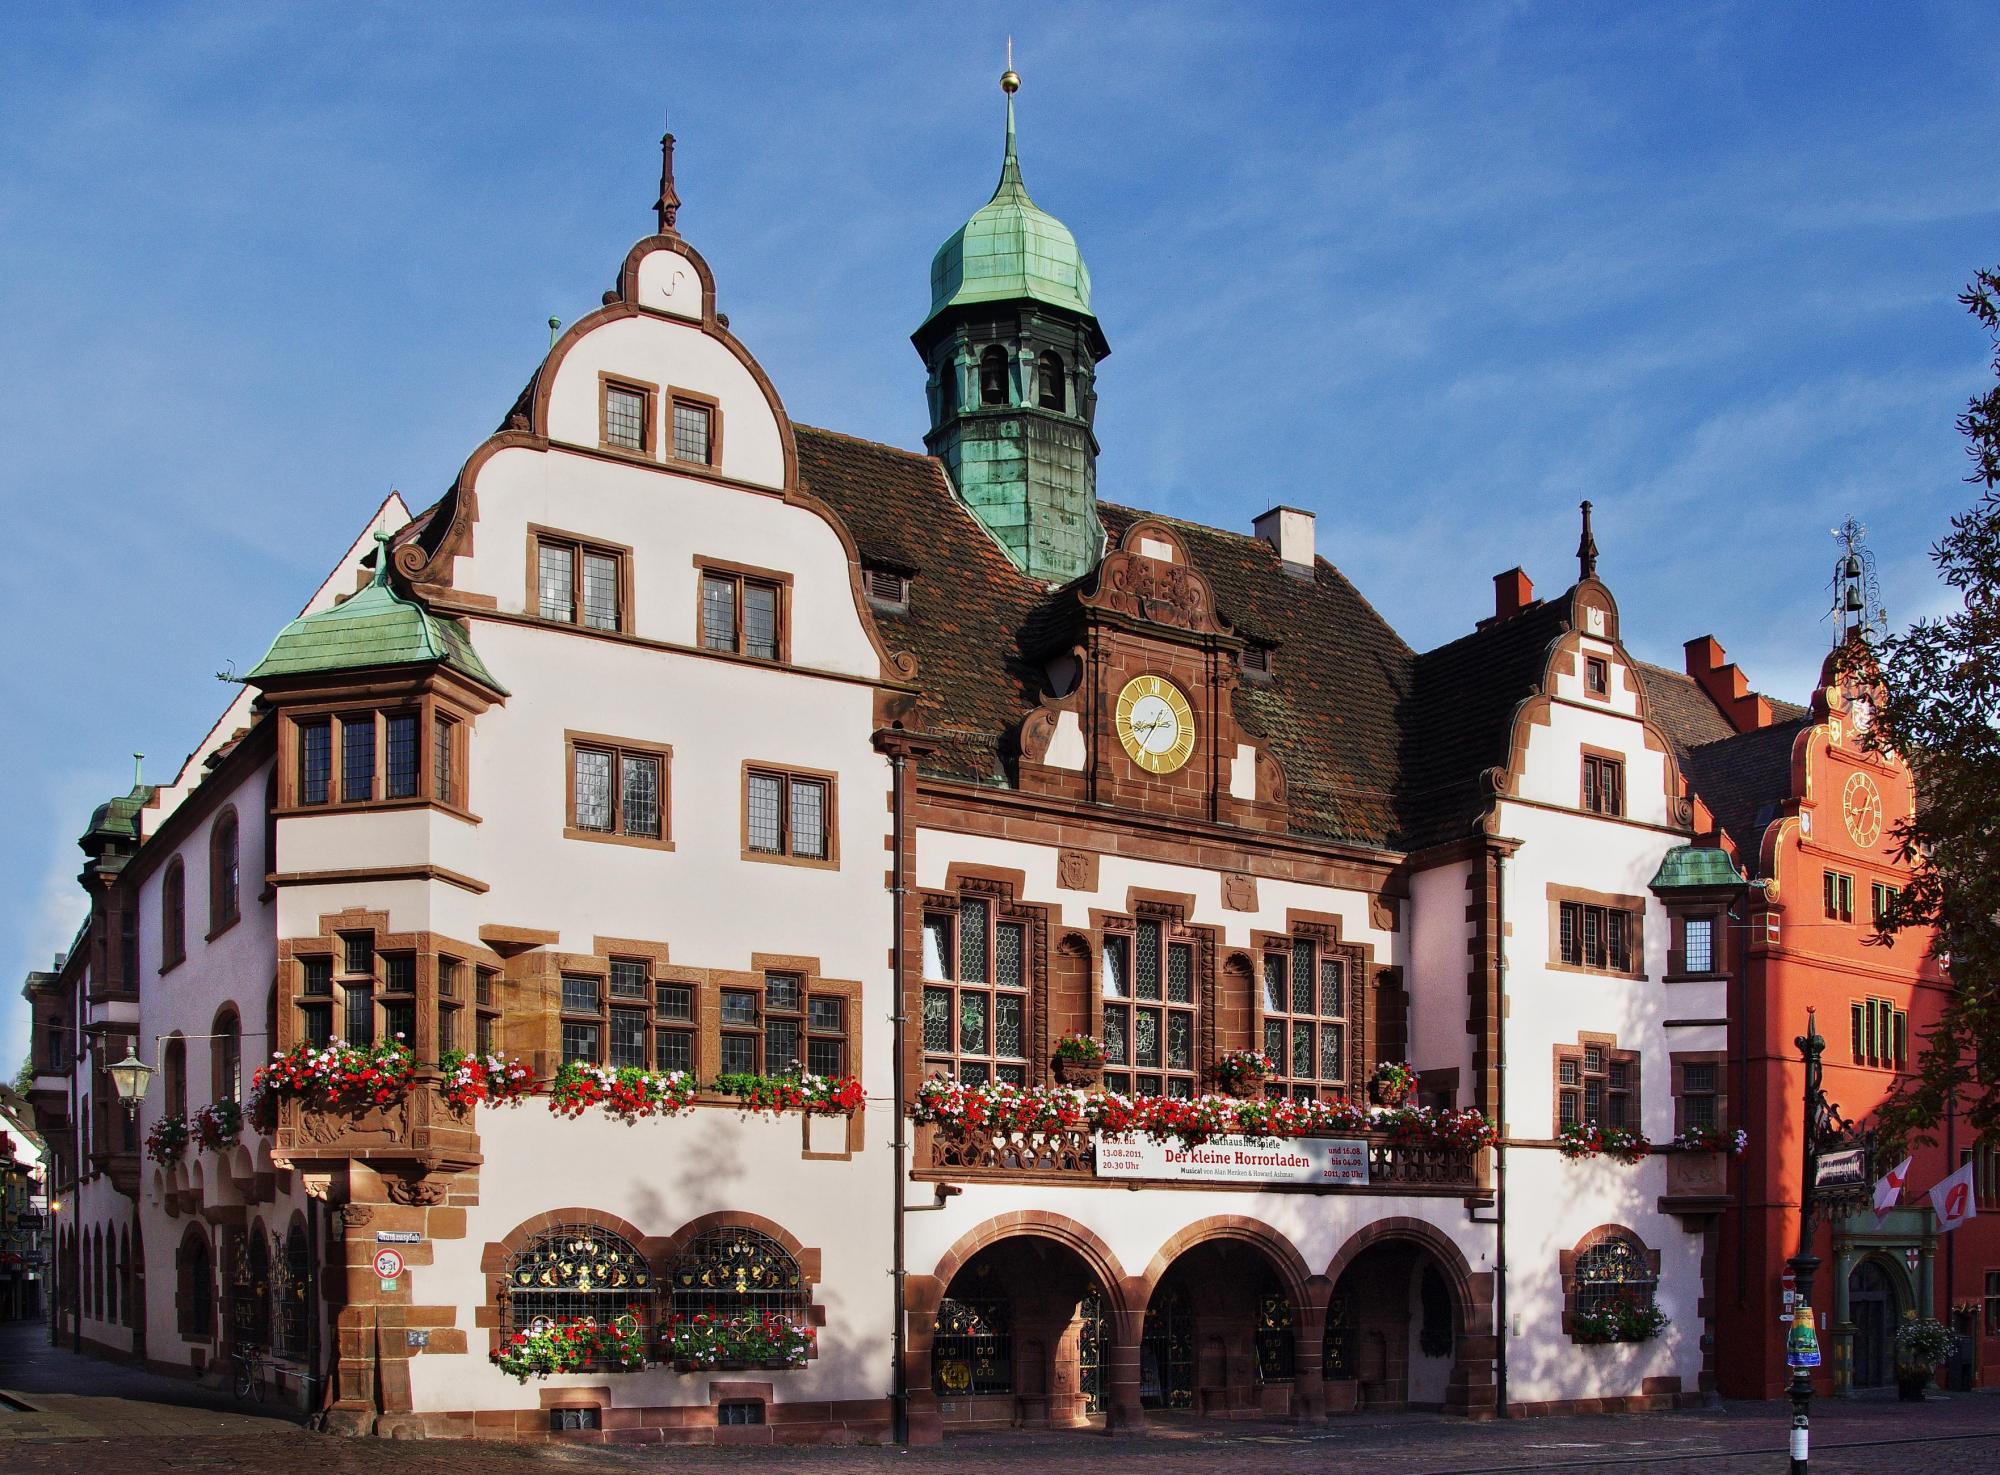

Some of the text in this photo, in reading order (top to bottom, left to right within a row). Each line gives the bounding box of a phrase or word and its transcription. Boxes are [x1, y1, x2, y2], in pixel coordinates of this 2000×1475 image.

[1103, 1150, 1144, 1159] 13.08.2011,
[1165, 1149, 1309, 1167] Der kleine Horrorladen
[1125, 1162, 1139, 1170] Uhr
[1332, 1158, 1341, 1166] bis
[1352, 1171, 1364, 1179] Uhr
